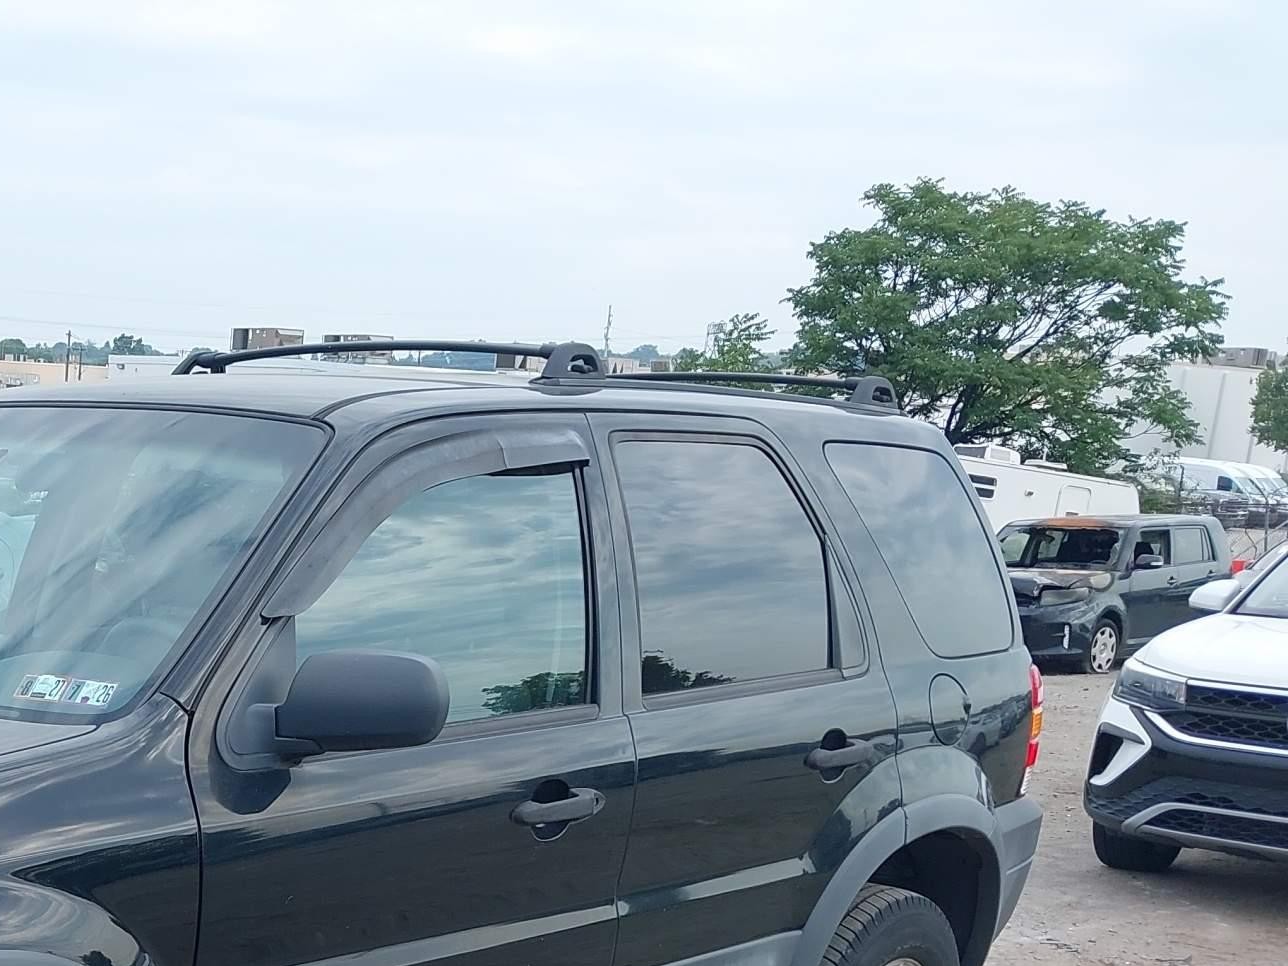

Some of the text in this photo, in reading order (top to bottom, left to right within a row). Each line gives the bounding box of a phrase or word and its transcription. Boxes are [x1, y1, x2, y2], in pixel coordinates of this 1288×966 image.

[21, 680, 66, 697] 8 27
[68, 684, 115, 704] 7 26
